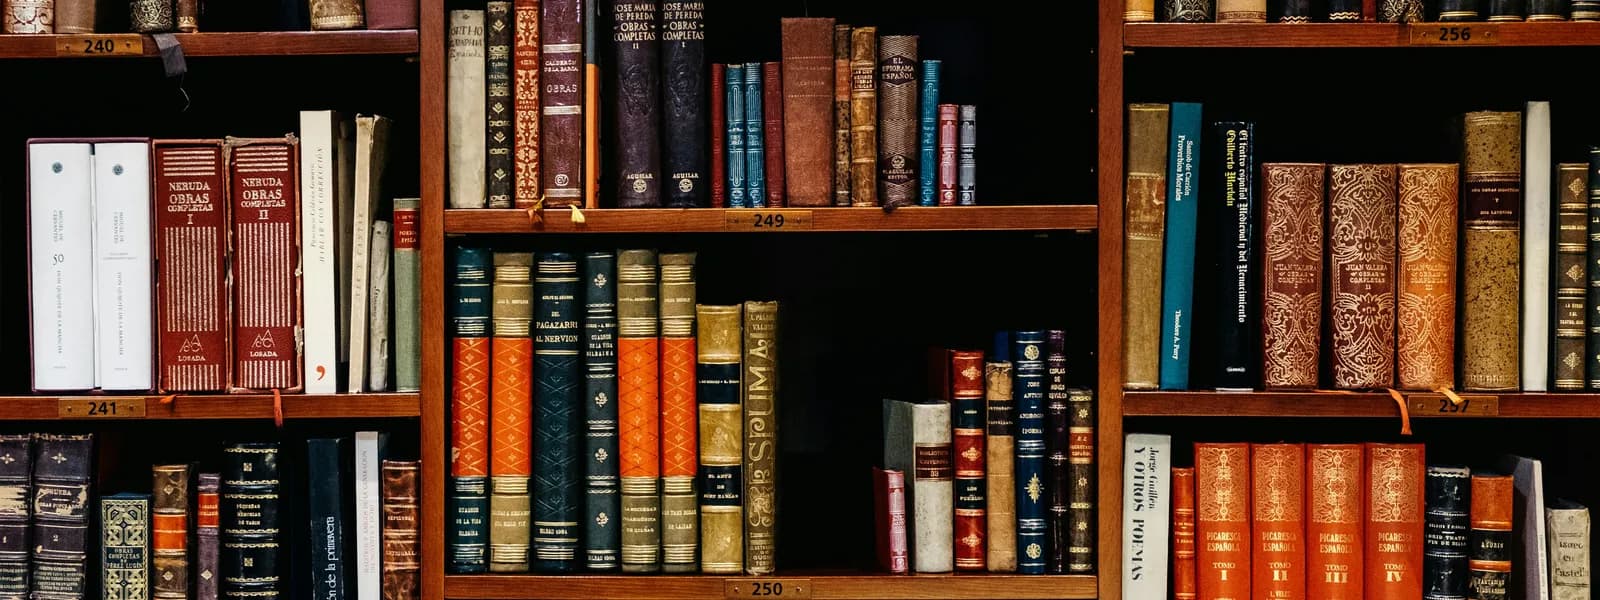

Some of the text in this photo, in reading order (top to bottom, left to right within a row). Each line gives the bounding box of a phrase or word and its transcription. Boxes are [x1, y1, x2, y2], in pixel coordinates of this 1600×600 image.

[662, 3, 681, 12] JOSE
[626, 12, 654, 20] PEREDA
[664, 12, 703, 20] DE PEREDA
[620, 22, 649, 31] OBRAS
[669, 22, 697, 30] OBRAS
[614, 31, 656, 41] COMPLETAS
[662, 31, 704, 40] COMPLETAS
[1438, 28, 1472, 42] 256
[84, 40, 115, 53] 240
[632, 42, 640, 50] II
[882, 70, 914, 80] ESPAÑOL
[546, 84, 577, 93] OBRAS
[1176, 135, 1185, 172] Proverbios
[1185, 163, 1192, 171] de
[169, 182, 210, 191] NERUDA
[242, 178, 284, 187] NERUDA
[169, 193, 210, 204] OBRAS
[243, 189, 282, 200] OBRAS
[168, 204, 213, 212] COMPLETAS
[241, 200, 286, 208] COMPLETAS
[188, 214, 193, 225] I
[258, 210, 269, 220] II
[754, 214, 784, 228] 249
[53, 254, 64, 265] 50
[88, 402, 117, 415] 241
[1439, 400, 1470, 412] 257
[1133, 461, 1144, 512] OTROS
[324, 516, 339, 560] primavera
[1206, 532, 1241, 541] PICARESCA
[1262, 532, 1297, 541] PICARESCA
[1132, 519, 1144, 580] POEMAS
[1207, 542, 1240, 552] ESPAÑOLA
[1263, 542, 1296, 552] ESPAÑOLA
[1320, 543, 1352, 553] ESPAÑOLA
[1378, 542, 1412, 552] ESPAÑOLA
[1220, 570, 1227, 581] I
[1273, 570, 1288, 581] II
[1325, 572, 1348, 583] III
[1386, 571, 1403, 582] IV
[325, 574, 336, 588] de
[752, 583, 783, 596] 250
